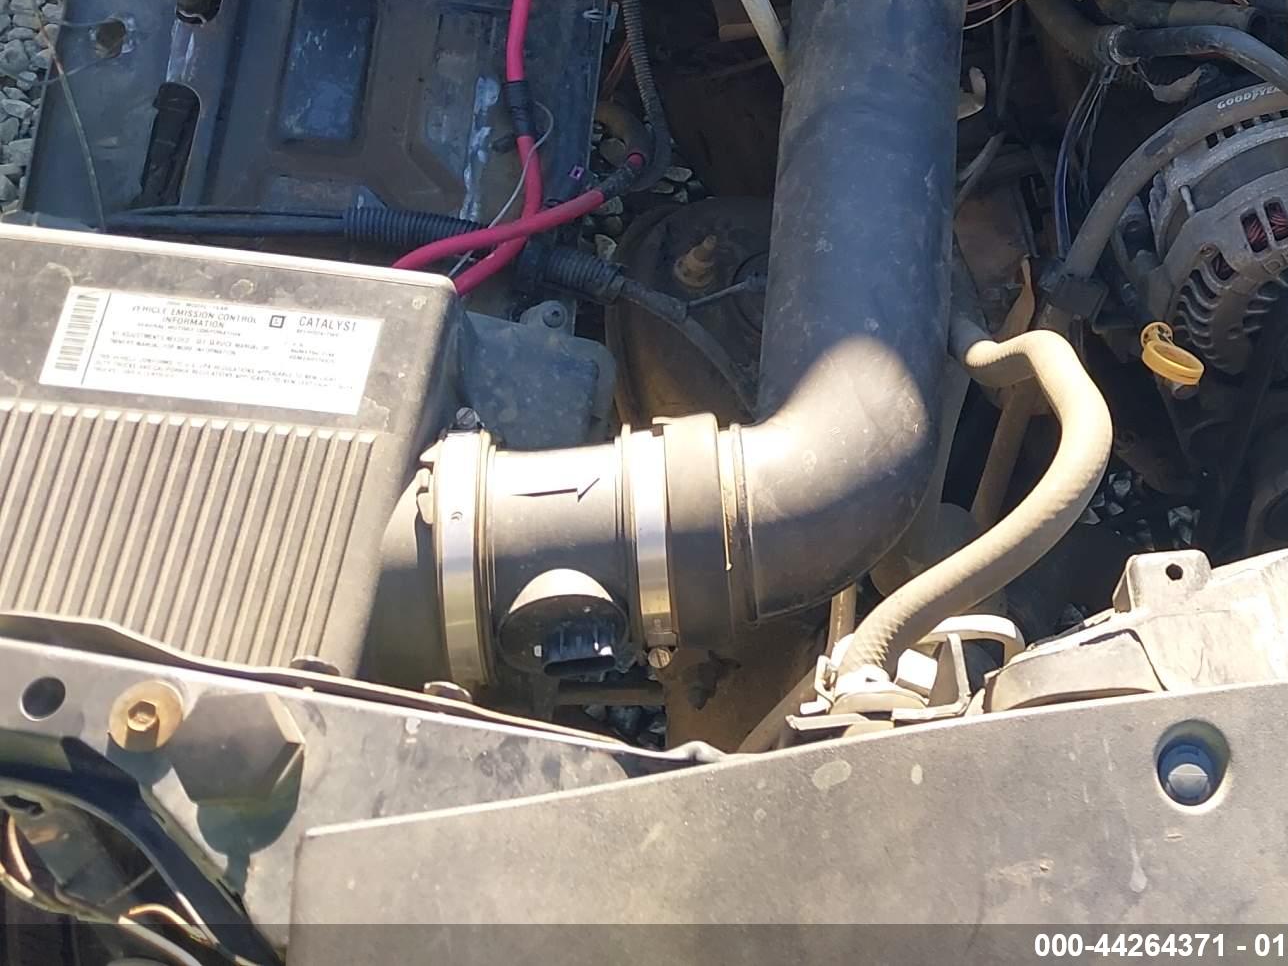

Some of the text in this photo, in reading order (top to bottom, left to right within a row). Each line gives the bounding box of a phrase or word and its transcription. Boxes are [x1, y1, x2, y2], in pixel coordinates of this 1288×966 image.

[132, 305, 168, 315] VEHICLE
[170, 309, 214, 320] EMISSION
[217, 313, 257, 324] CONTROL
[162, 317, 225, 329] INFORMATION
[298, 315, 357, 332] CATALYST
